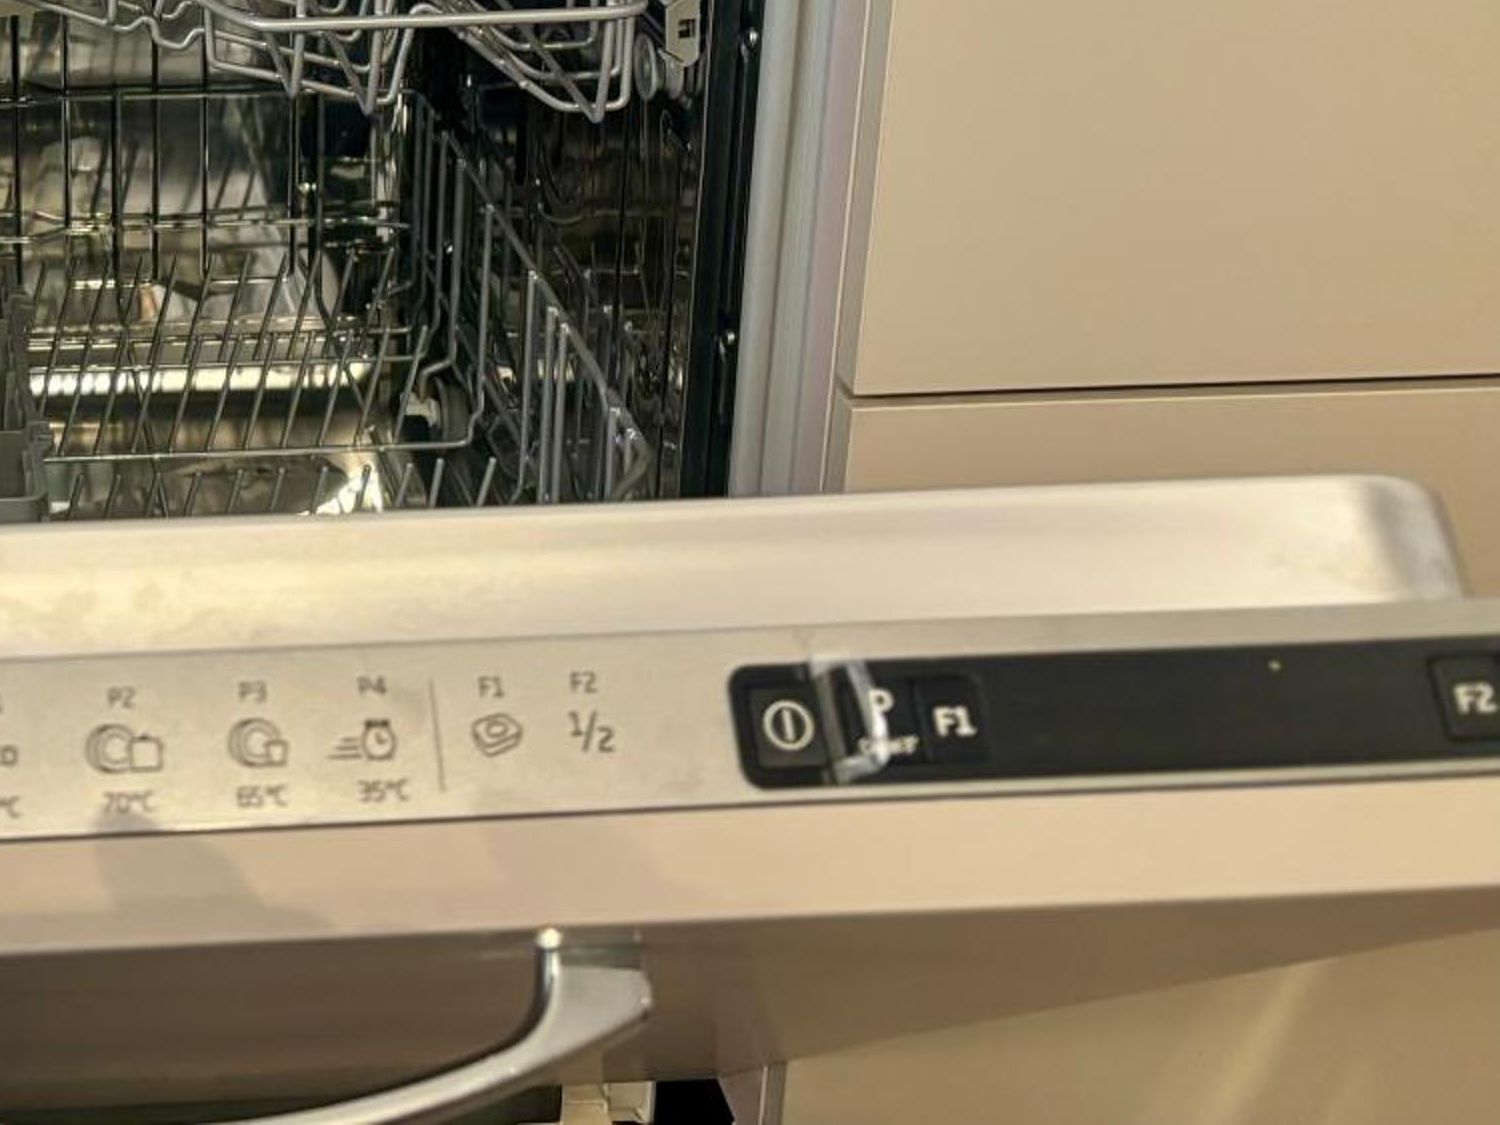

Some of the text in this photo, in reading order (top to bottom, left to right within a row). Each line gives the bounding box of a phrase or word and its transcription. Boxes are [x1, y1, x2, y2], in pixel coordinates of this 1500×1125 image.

[238, 681, 267, 703] P3
[358, 676, 387, 696] P4
[478, 676, 505, 698] F1
[569, 671, 598, 694] F2
[107, 687, 136, 709] P2
[1454, 682, 1498, 713] F2
[933, 705, 977, 737] F1
